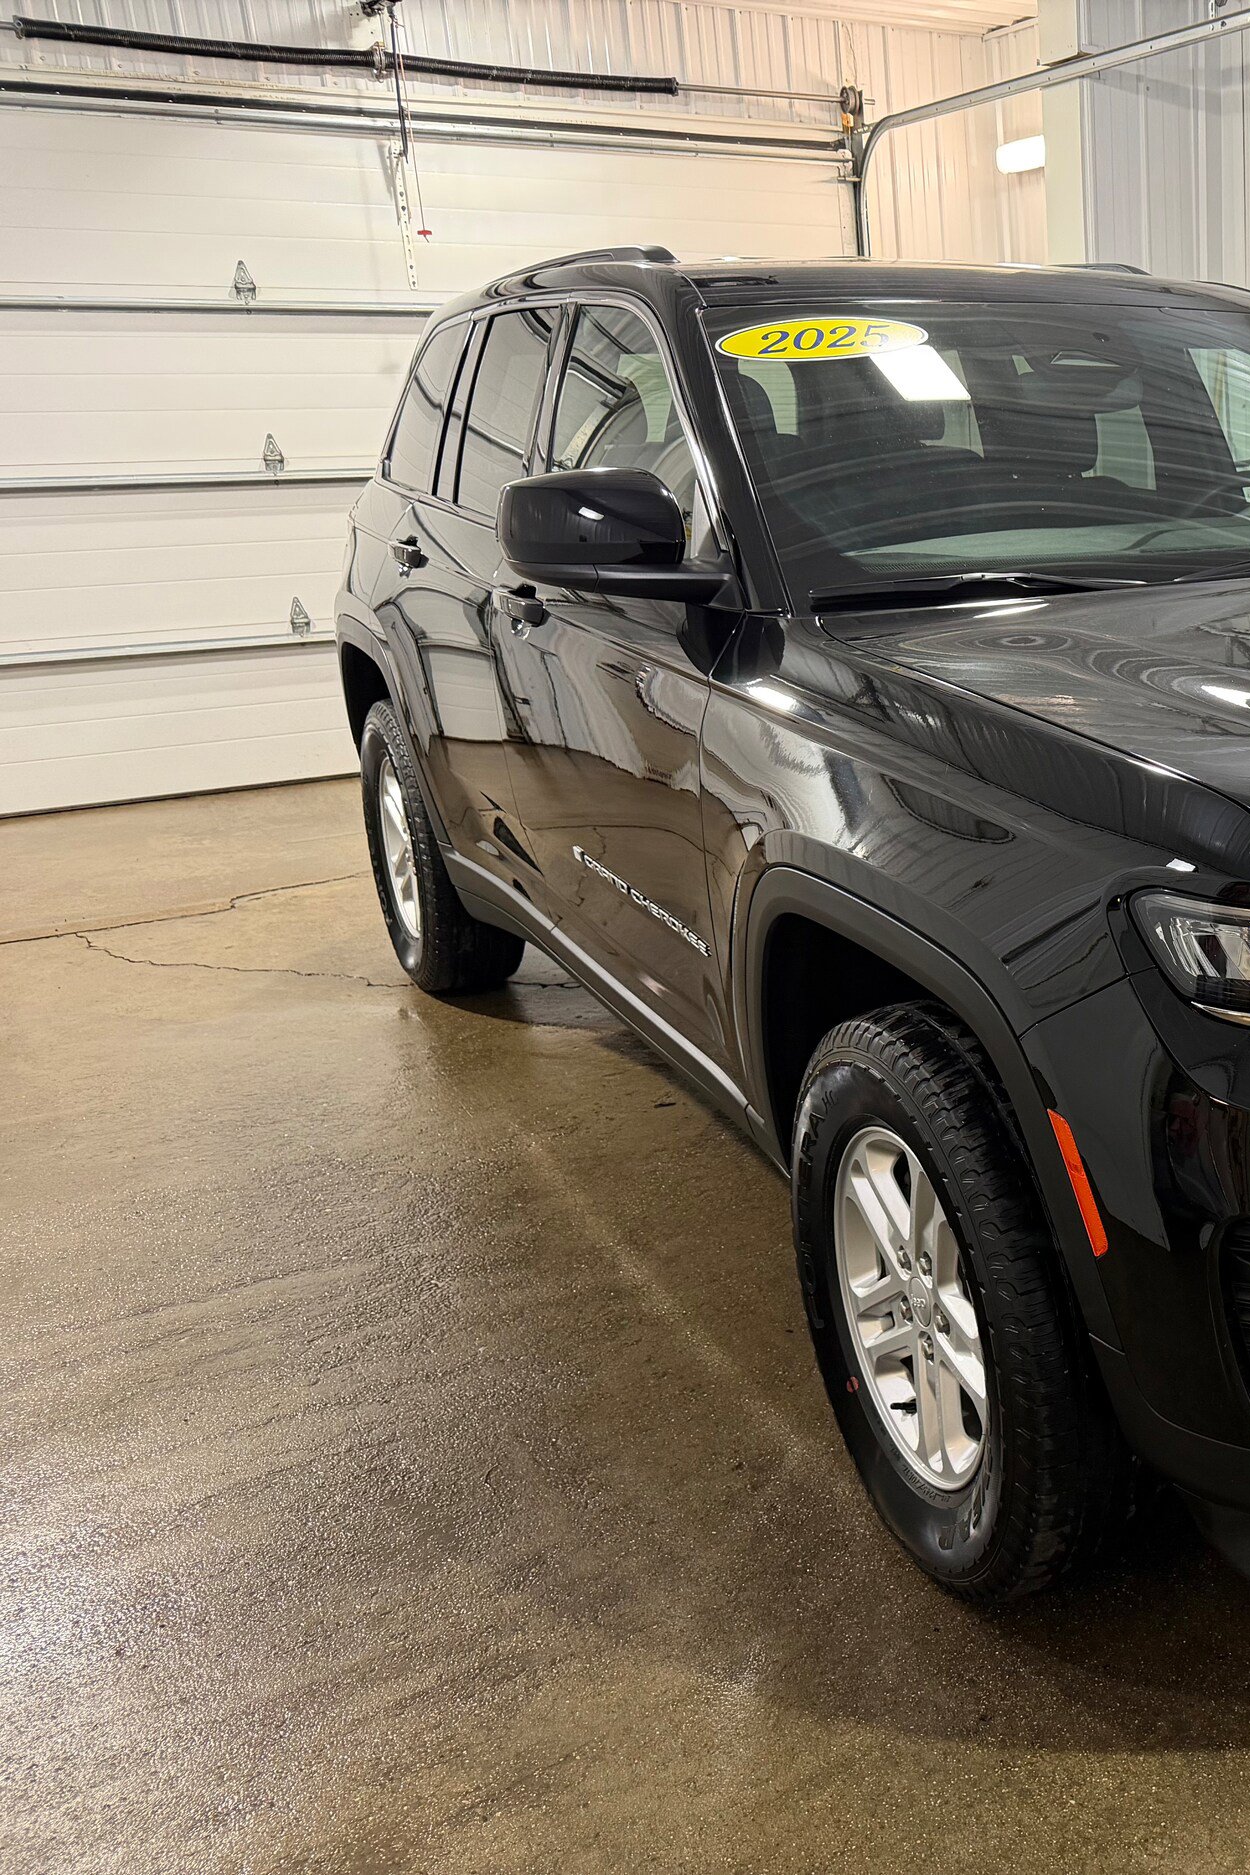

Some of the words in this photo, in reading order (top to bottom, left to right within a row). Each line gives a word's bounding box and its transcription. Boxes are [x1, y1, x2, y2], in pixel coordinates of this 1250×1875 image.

[757, 324, 890, 355] 2025
[583, 854, 631, 895] GRAND
[630, 888, 711, 957] CHEROKEE
